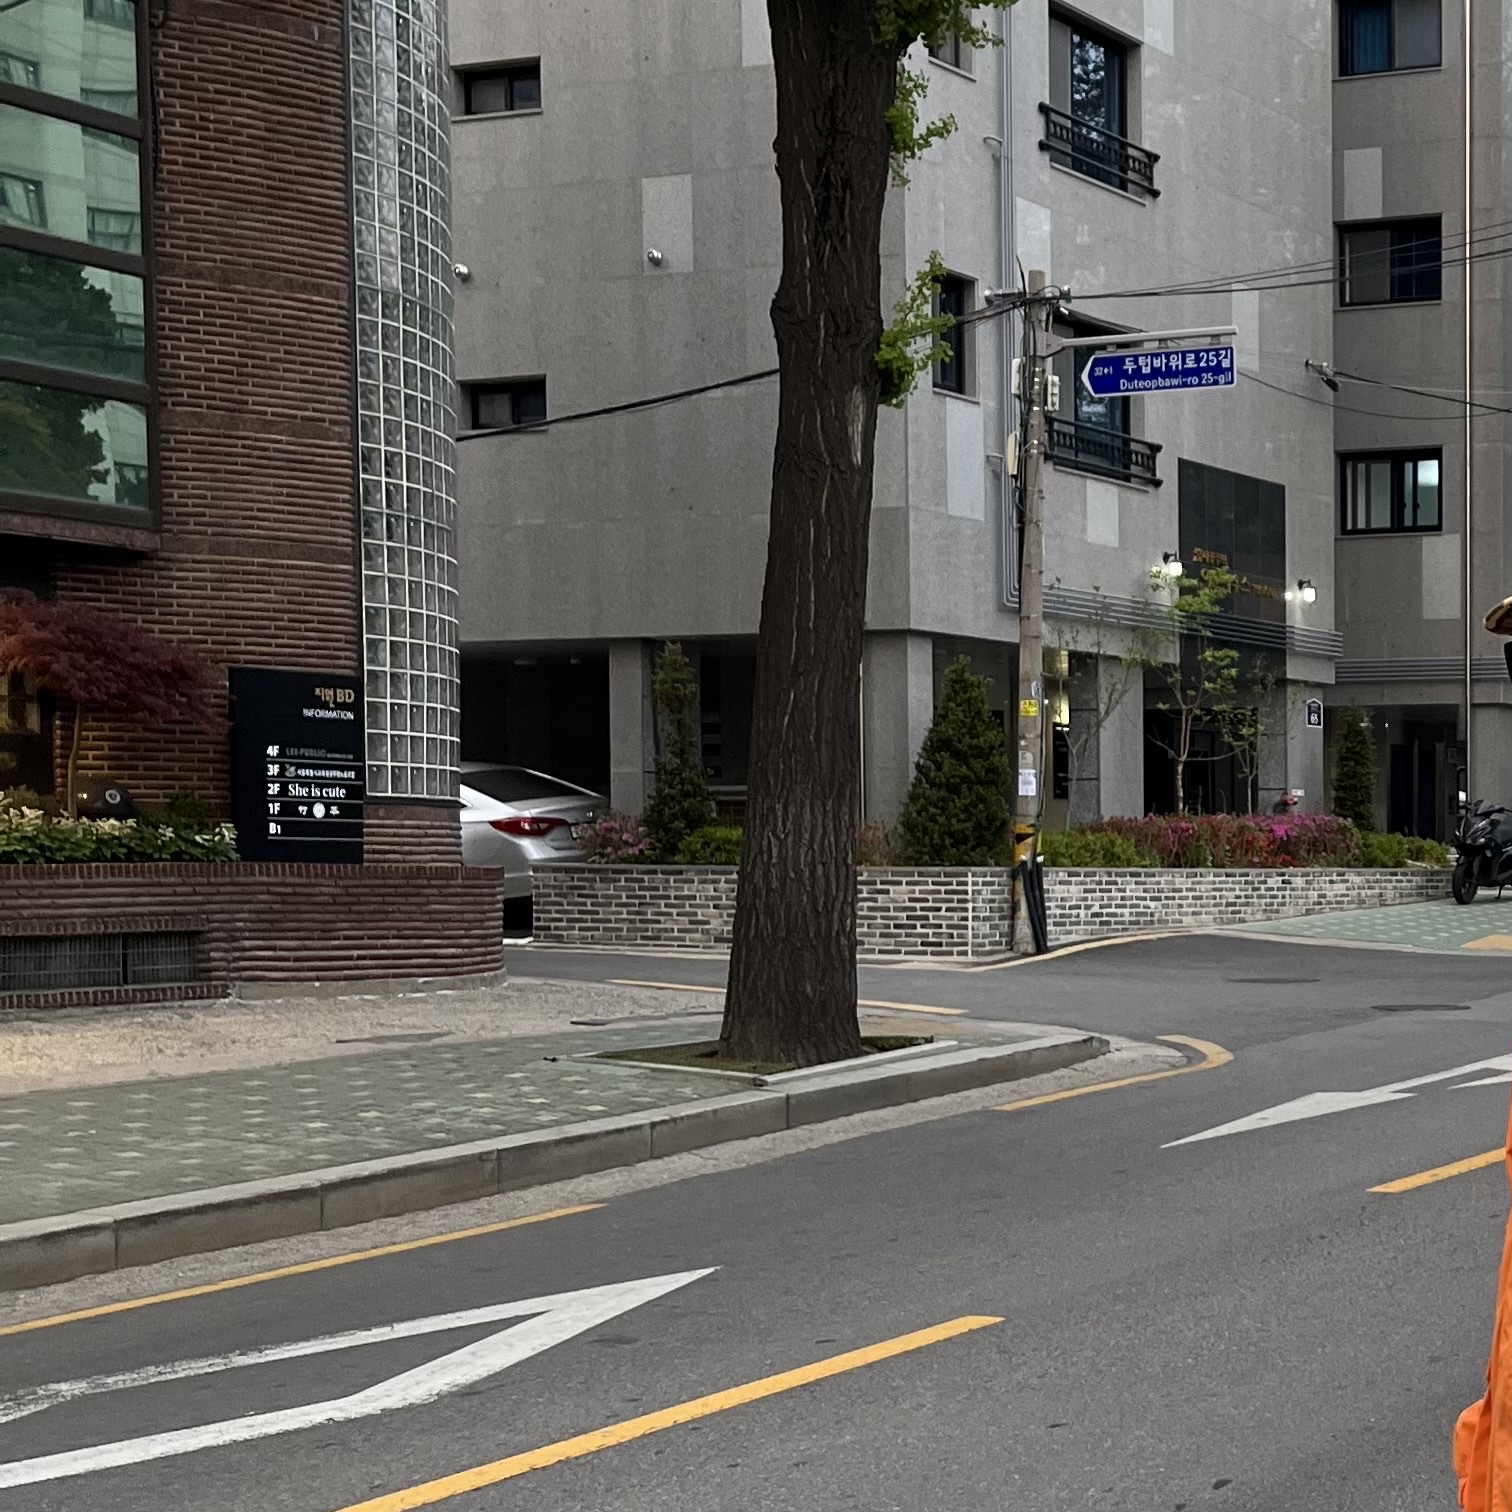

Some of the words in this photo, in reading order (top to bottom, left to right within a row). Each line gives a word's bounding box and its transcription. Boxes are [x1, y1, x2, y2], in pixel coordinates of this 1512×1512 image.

[1122, 349, 1231, 375] 두텁바위로25길
[1120, 375, 1199, 390] Duteopbawi-ro
[1201, 371, 1232, 386] 25-gil
[336, 688, 355, 703] BD
[303, 708, 354, 720] INFORMATION
[266, 746, 279, 757] 4F
[267, 765, 280, 776] 3F
[267, 784, 280, 795] 2F
[288, 783, 309, 798] She
[311, 784, 320, 798] is
[322, 787, 347, 798] cute
[268, 803, 280, 815] 1F
[269, 822, 282, 835] B1
